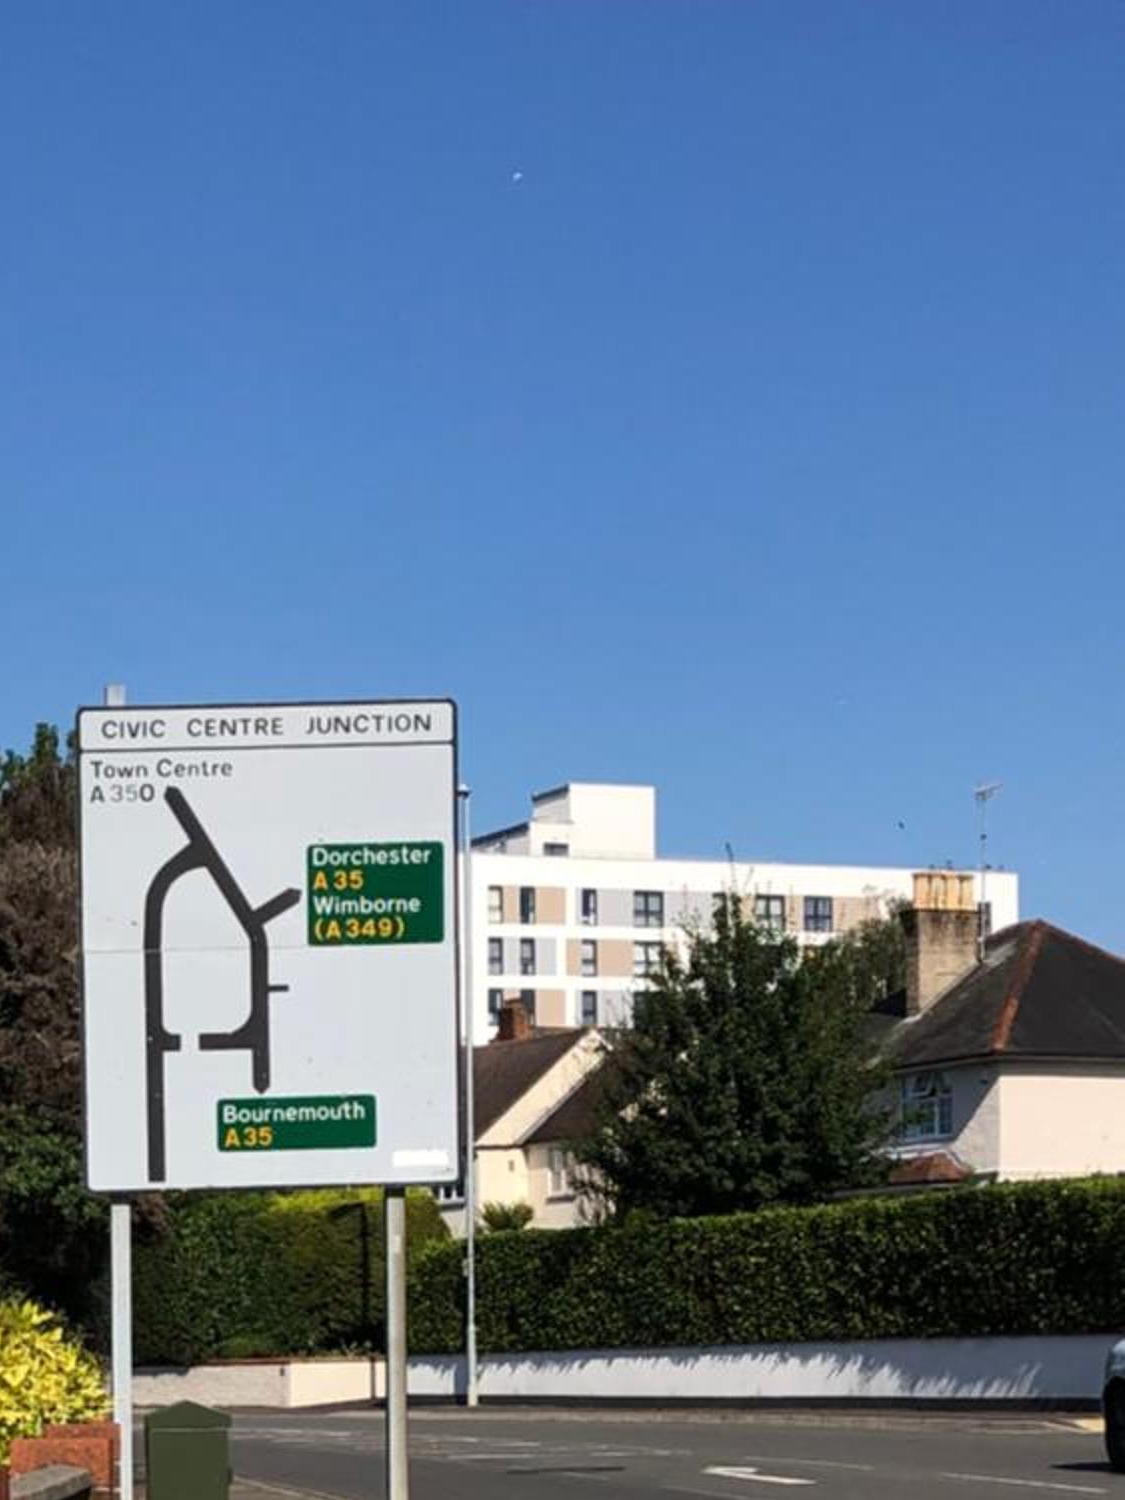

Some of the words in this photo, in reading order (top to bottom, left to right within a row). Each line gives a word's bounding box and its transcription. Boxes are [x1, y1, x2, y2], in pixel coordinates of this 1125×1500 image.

[101, 719, 167, 740] CIVIC
[186, 717, 285, 738] CENTRE
[306, 714, 432, 735] JUNCTION
[90, 761, 149, 779] Town
[156, 758, 233, 778] Centre
[312, 846, 432, 867] Dorchester
[313, 896, 422, 915] Wimborne
[222, 1102, 366, 1125] Bournemouth
